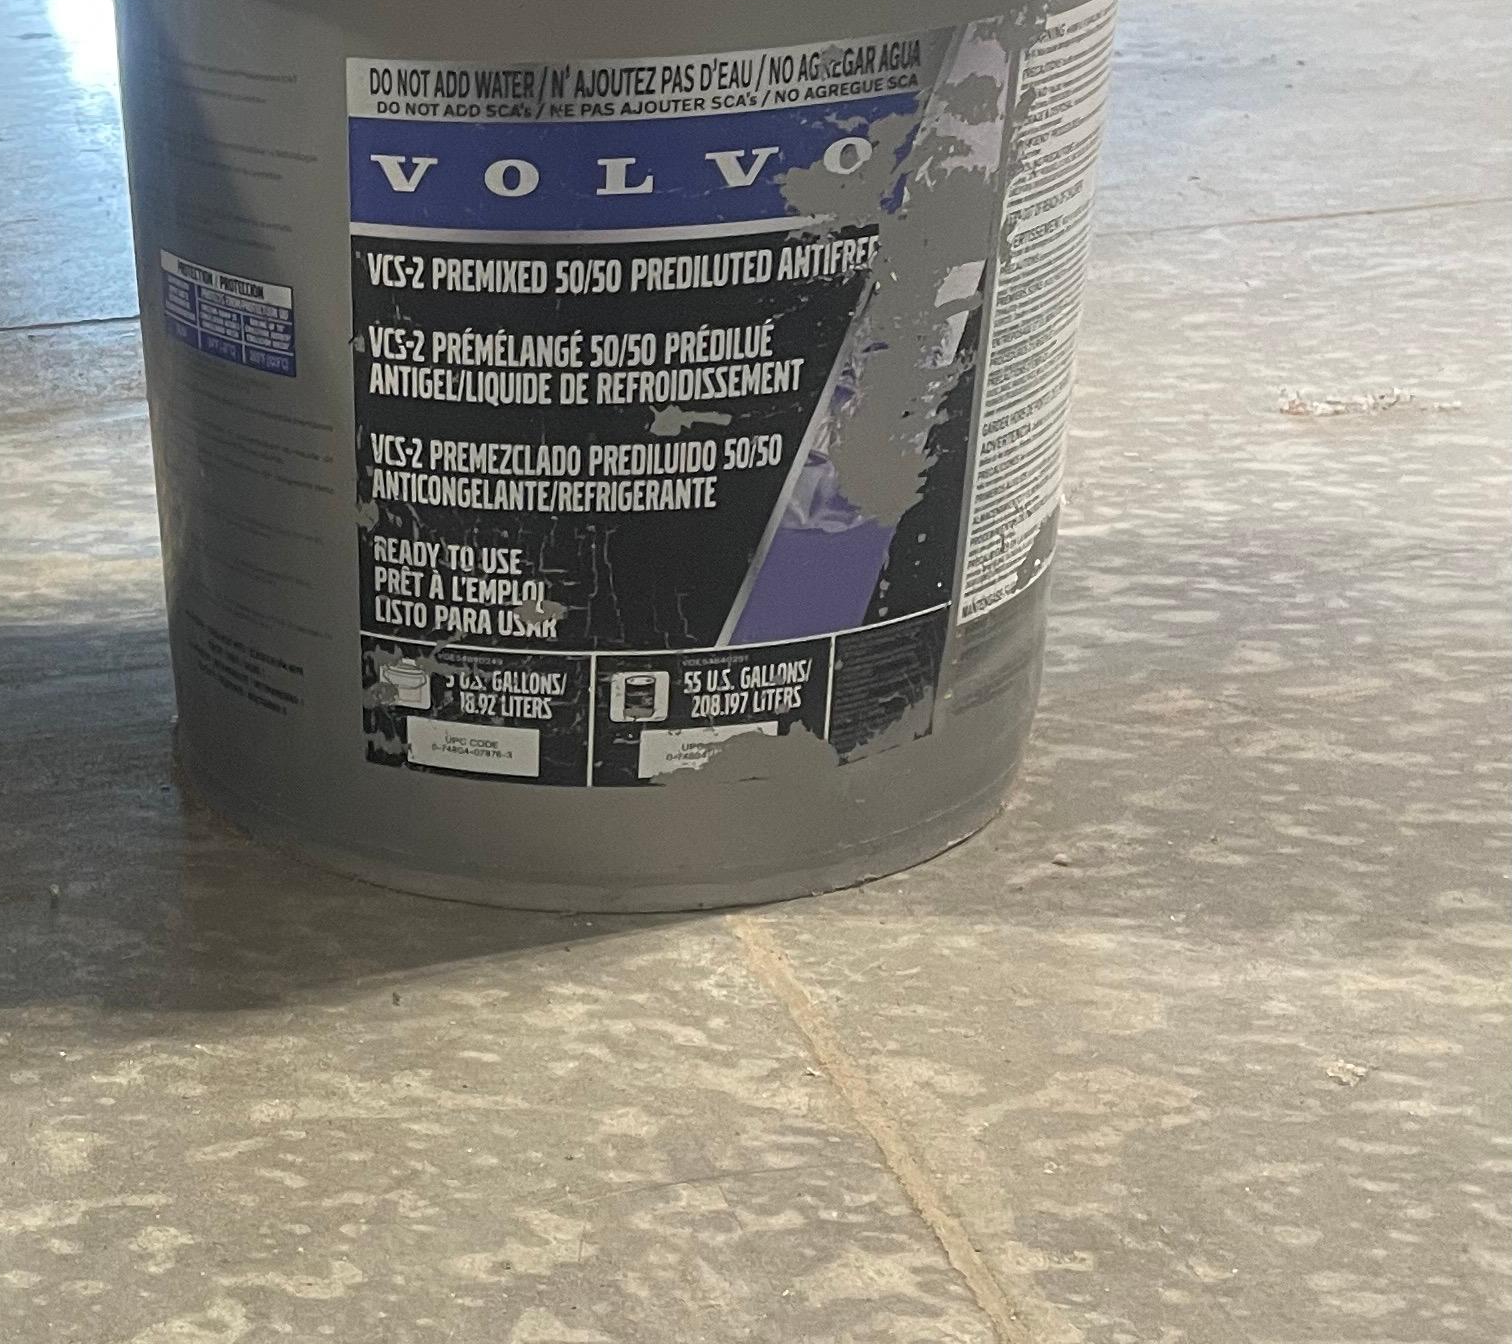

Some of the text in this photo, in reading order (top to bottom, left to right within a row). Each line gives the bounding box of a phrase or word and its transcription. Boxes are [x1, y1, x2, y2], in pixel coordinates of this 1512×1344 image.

[369, 67, 392, 95] DO
[397, 68, 431, 97] NOT
[434, 69, 470, 98] ADD
[476, 70, 535, 99] WATER
[576, 66, 657, 99] AJOUTEZ
[661, 64, 695, 94] PAS
[700, 57, 753, 94] D'EAU
[769, 55, 794, 86] NO
[878, 39, 921, 72] AGUA
[377, 101, 400, 114] DO
[405, 102, 440, 116] NOT
[443, 103, 480, 117] ADD
[580, 101, 614, 116] PAS
[621, 98, 705, 115] AJOUTER
[775, 88, 799, 104] NO
[804, 77, 883, 100] AGREGUE
[887, 73, 919, 89] SCA
[370, 137, 872, 197] VOLVO
[367, 252, 424, 288] VCS-2
[432, 257, 548, 293] PREMIXED
[555, 259, 622, 294] 50/50
[630, 249, 773, 292] PREDILUTED
[369, 318, 775, 368] VCS-2 PRÉMÉLANGÉ 50/50 PRÉDILUÉ
[369, 358, 805, 406] ANTIGEL/LIQUIDE DE REFROIDISSEMENT
[370, 433, 783, 477] VCS-2 PREMEZCLADO PREDILUIDO 50/50
[371, 469, 718, 513] ANTICONGELANTE/REFRIGERANTE
[373, 535, 523, 575] READY TO USE
[374, 566, 424, 598] PRÊT
[428, 568, 444, 600] À
[374, 594, 427, 629] LISTO
[434, 605, 492, 636] PARA
[492, 670, 567, 696] GALLONS/
[683, 670, 702, 694] 55
[706, 667, 735, 693] U.S.
[740, 658, 813, 689] GALLONS/
[460, 691, 553, 720] 18.92 LITERS
[690, 685, 802, 718] 208.197 LITERS
[445, 735, 499, 749] UPC CODE
